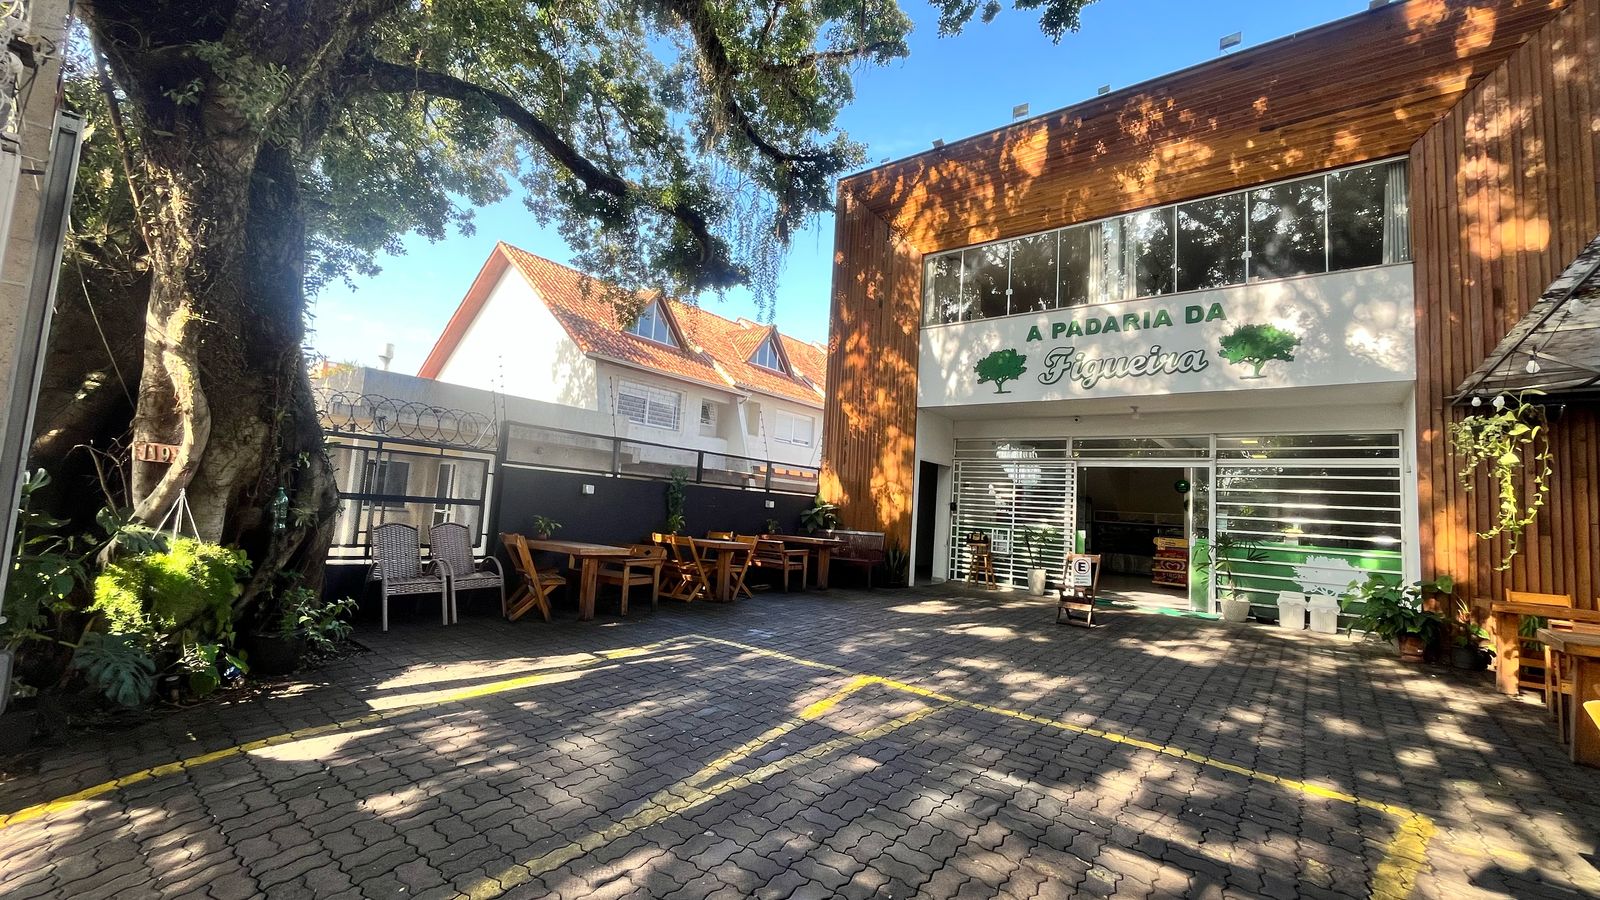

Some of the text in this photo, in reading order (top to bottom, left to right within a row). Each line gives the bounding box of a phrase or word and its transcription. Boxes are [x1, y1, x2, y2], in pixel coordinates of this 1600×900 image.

[1026, 303, 1227, 342] A PADARIA DA
[1038, 345, 1209, 389] Figueira
[1079, 562, 1087, 572] E
